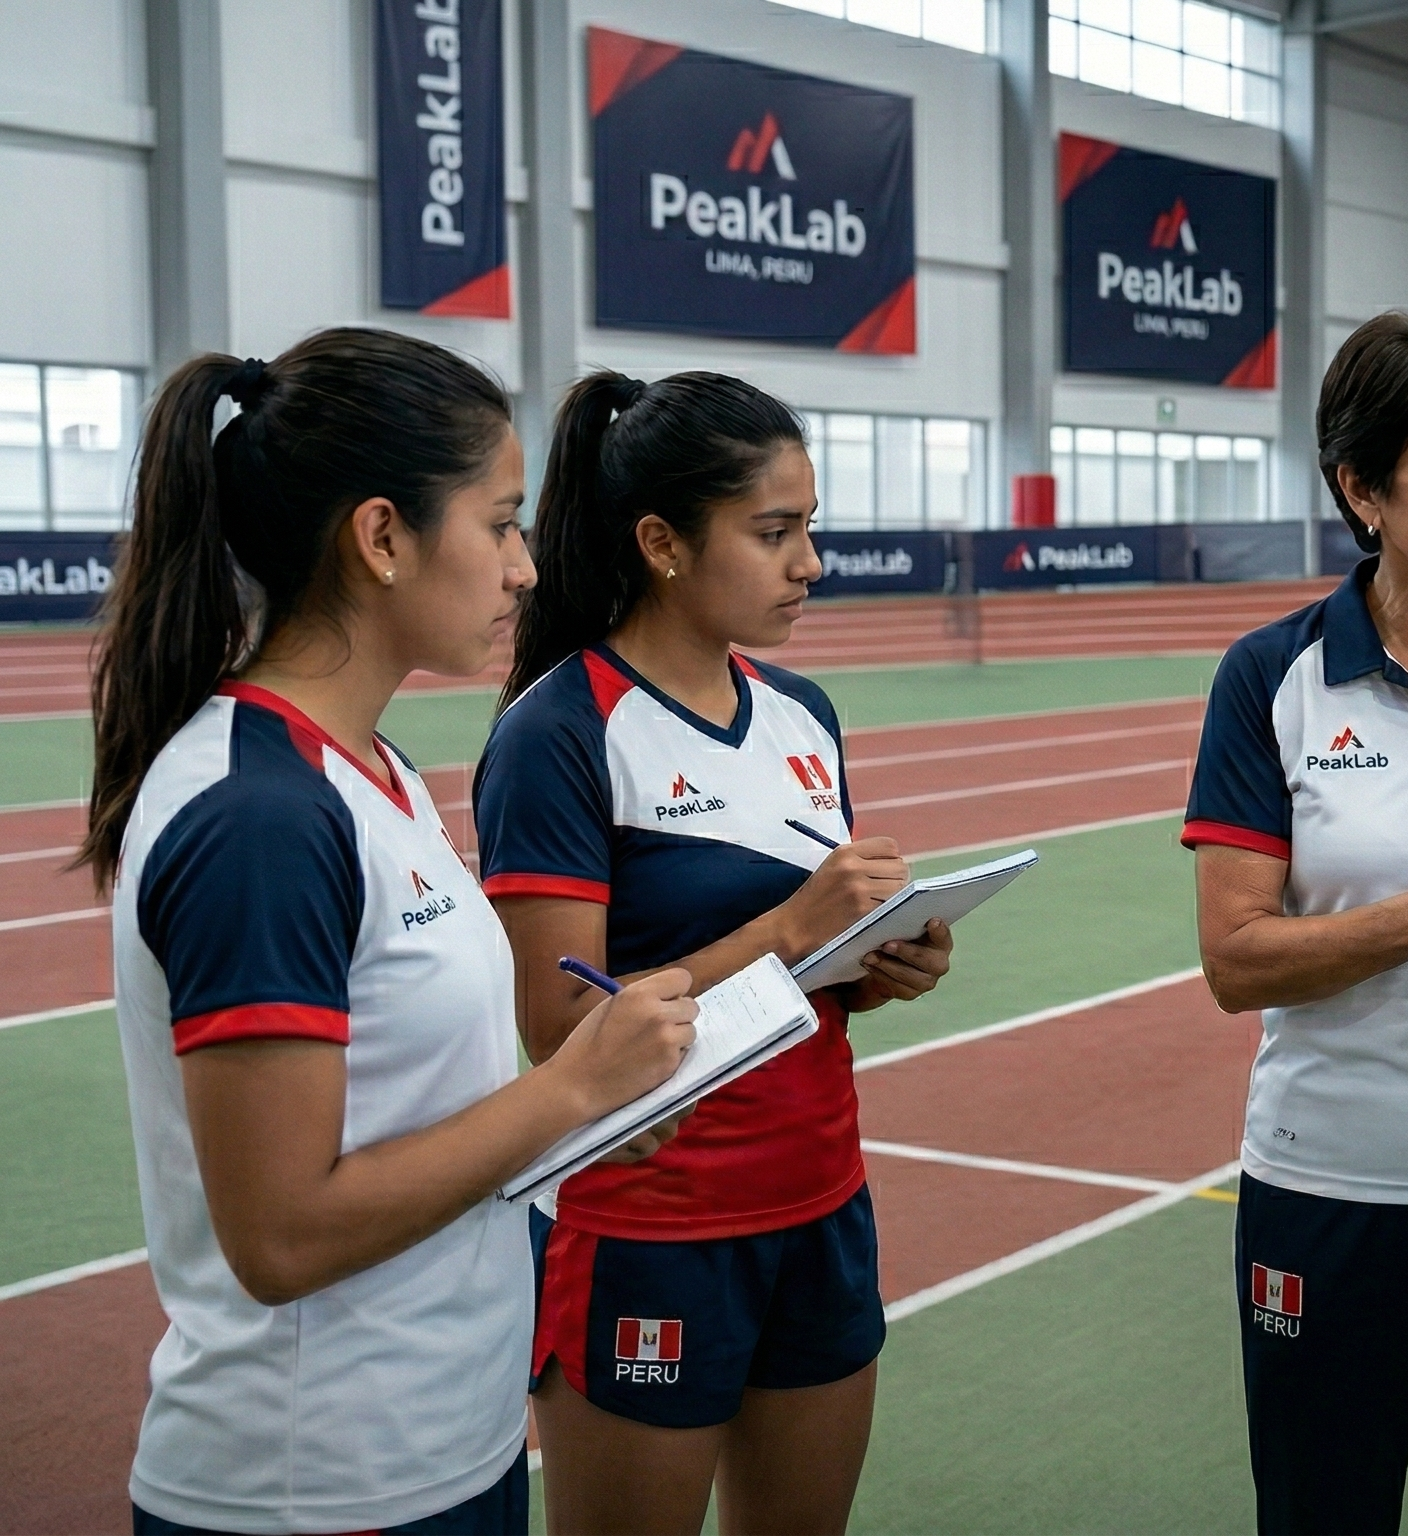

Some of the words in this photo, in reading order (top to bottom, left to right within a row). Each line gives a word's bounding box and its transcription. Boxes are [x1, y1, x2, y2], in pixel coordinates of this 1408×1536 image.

[649, 172, 867, 258] PeakLab
[1098, 252, 1243, 316] PeakLab
[822, 547, 913, 577] PeakLab
[1038, 542, 1133, 571] PeakLab
[1306, 752, 1389, 770] PeakLab
[655, 796, 726, 821] PeakLab
[1253, 1308, 1300, 1338] PERU
[615, 1363, 680, 1384] PERU
